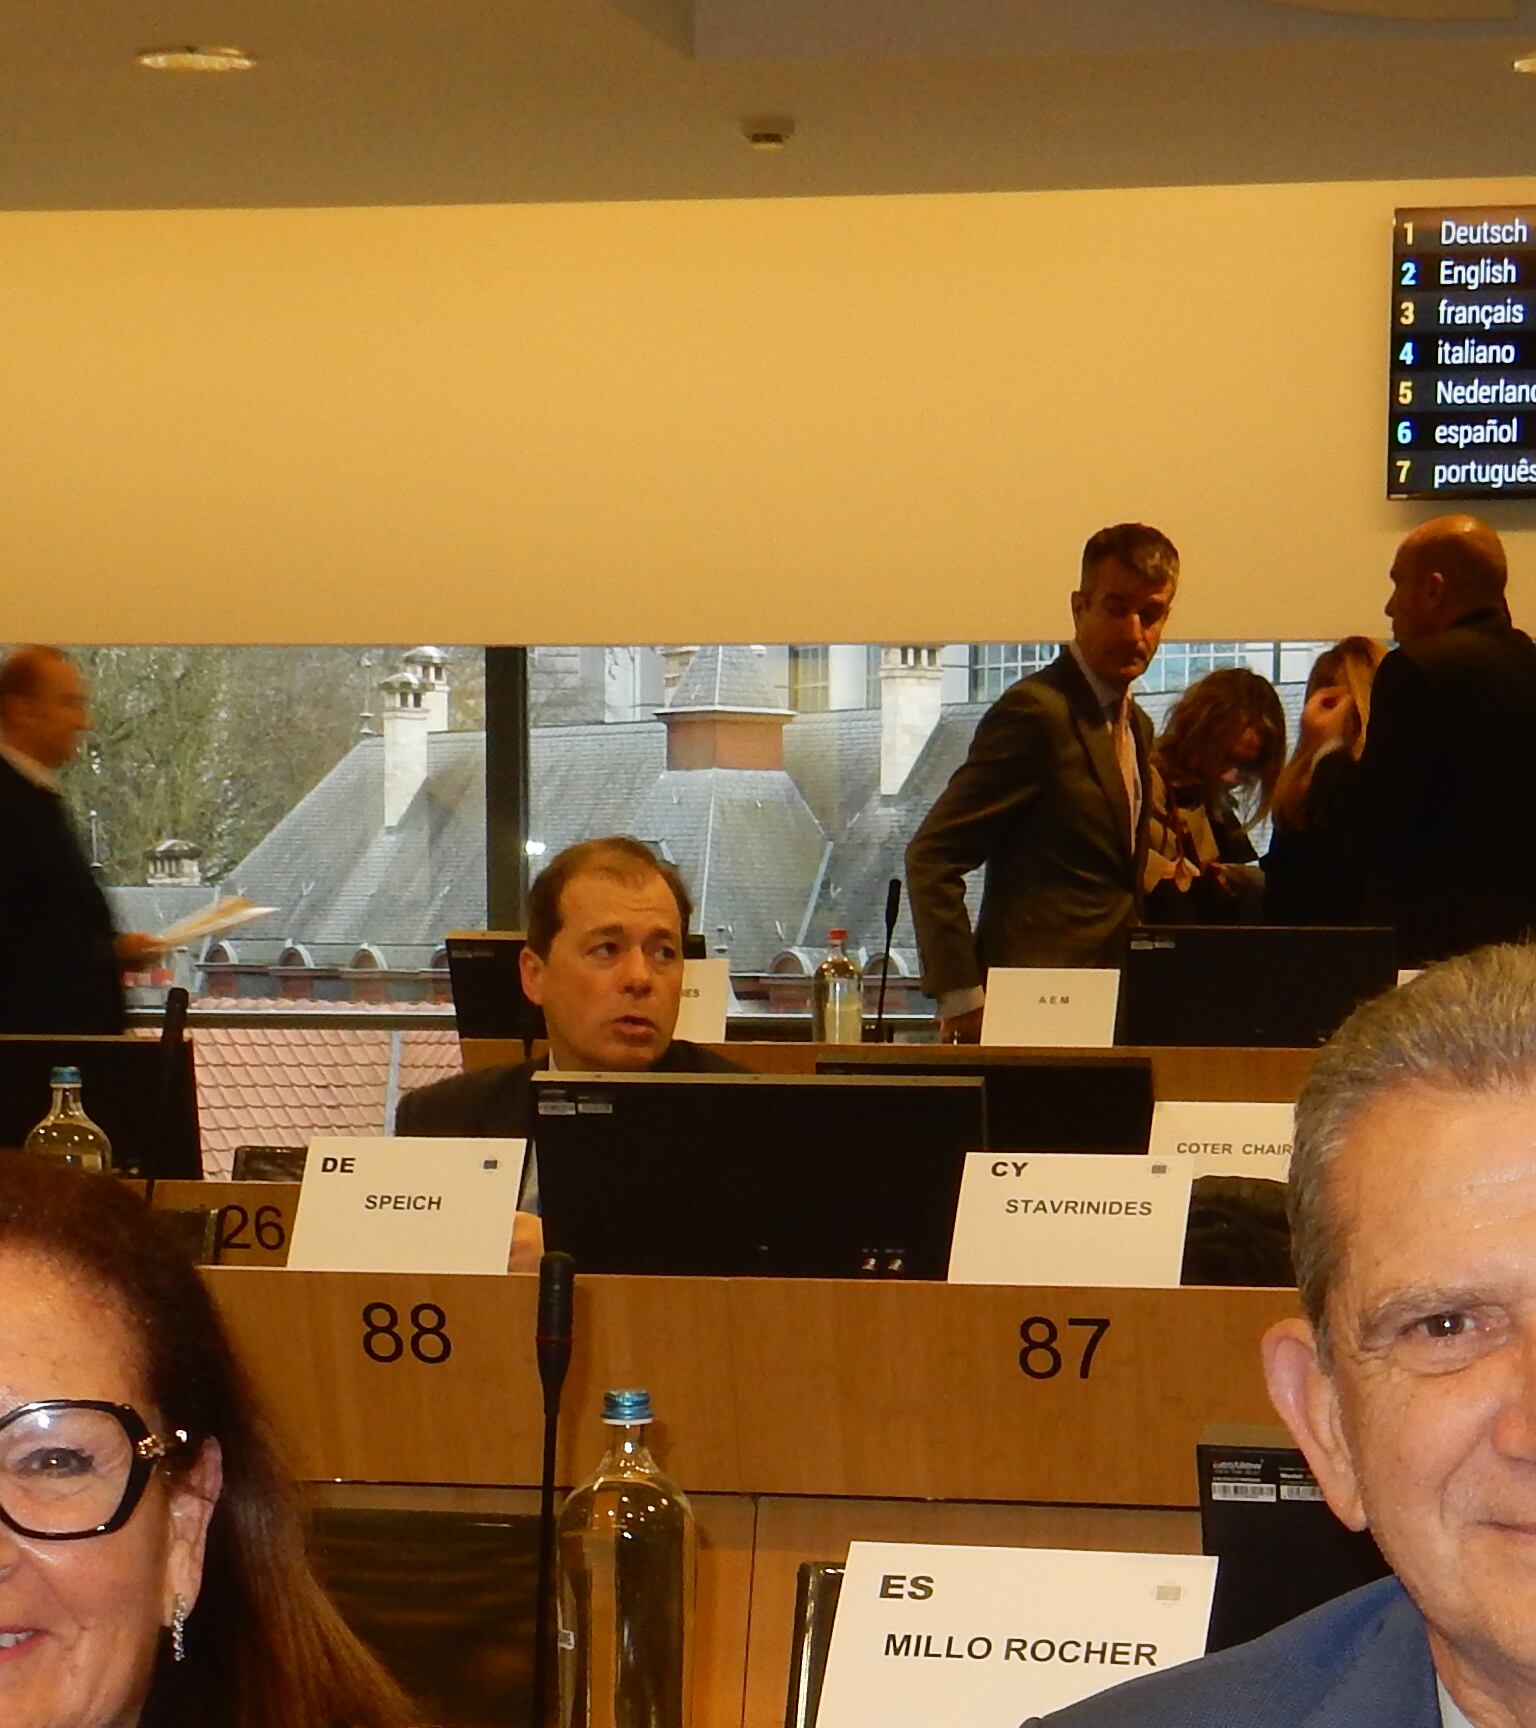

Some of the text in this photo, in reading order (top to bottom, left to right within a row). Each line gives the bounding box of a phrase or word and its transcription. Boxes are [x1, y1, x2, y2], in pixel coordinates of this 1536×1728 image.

[1403, 217, 1528, 245] 1 Deutsch
[1400, 258, 1517, 289] 2 English
[1400, 298, 1524, 330] 3 français
[1398, 338, 1516, 365] 4 italiano
[1398, 381, 1413, 405] 5
[1397, 417, 1518, 449] 6 español
[1395, 460, 1411, 483] 7
[1176, 1142, 1294, 1156] COTER CHAIR
[321, 1157, 356, 1175] DE
[991, 1161, 1030, 1178] CY
[364, 1194, 443, 1212] SPEICH
[1005, 1198, 1154, 1217] STAVRINIDES
[362, 1301, 453, 1364] 88
[1018, 1316, 1112, 1380] 87
[878, 1574, 935, 1601] ES
[883, 1633, 1158, 1667] MILLO ROCHER
